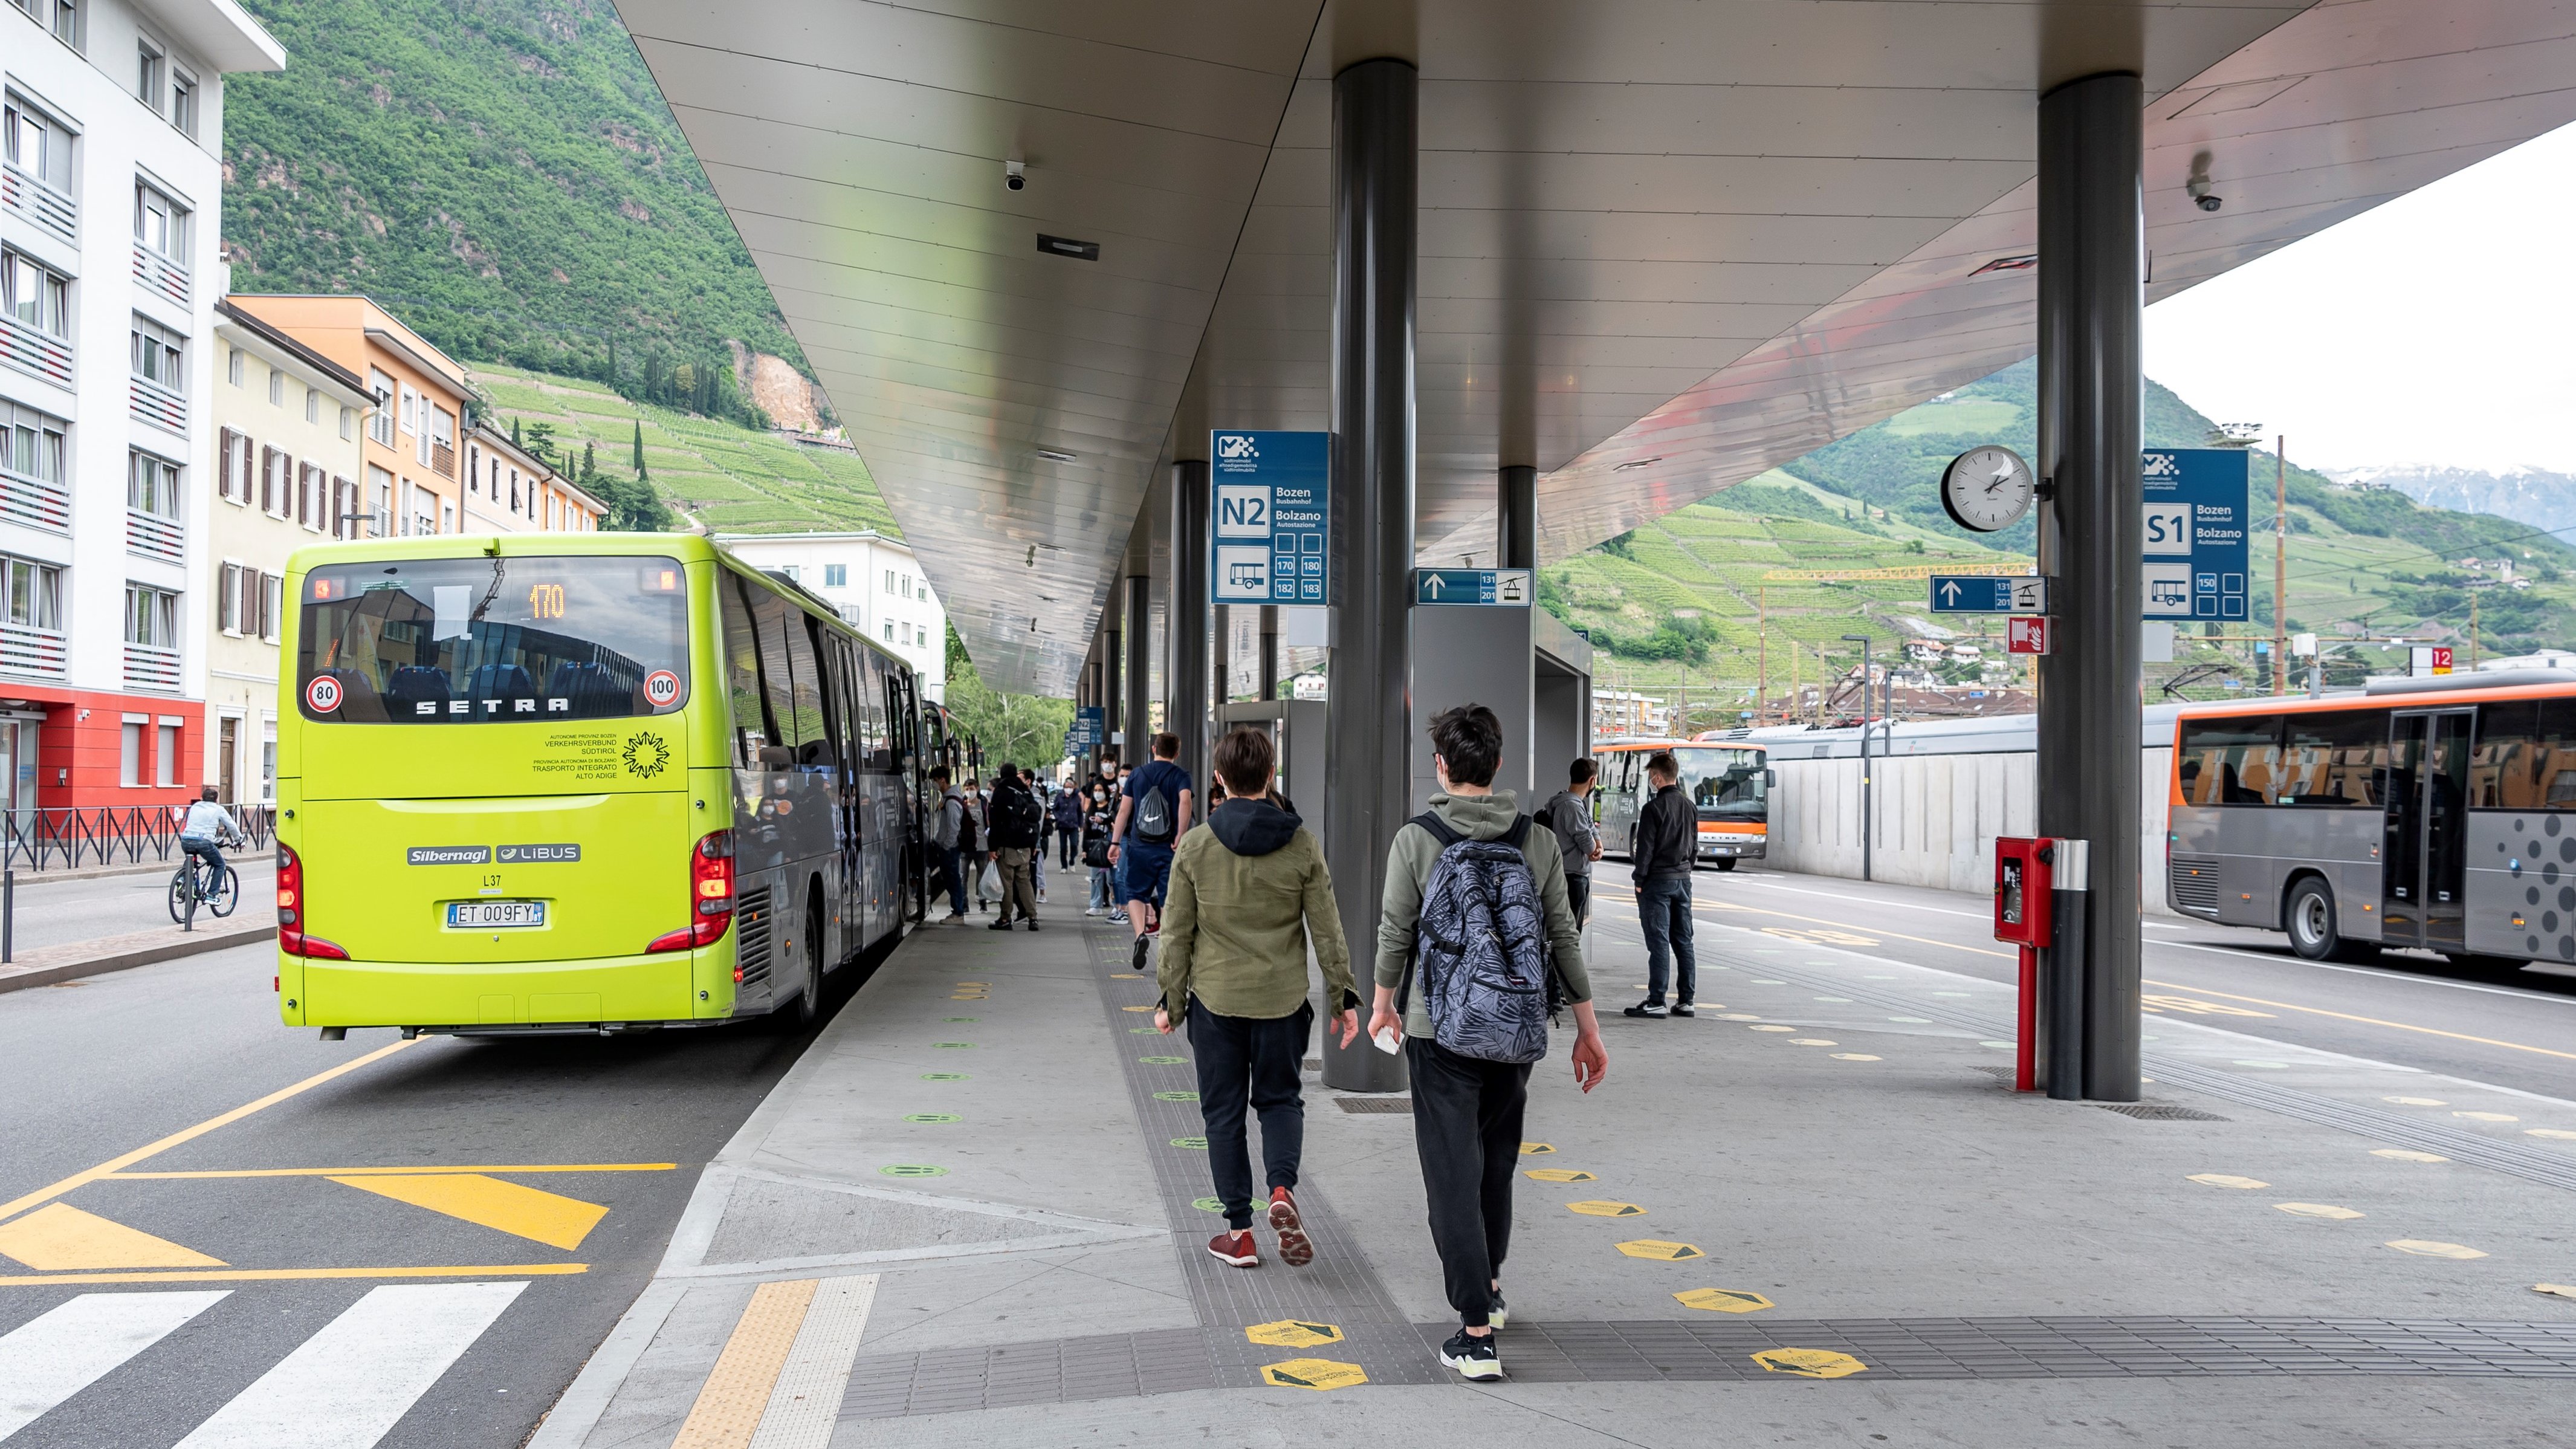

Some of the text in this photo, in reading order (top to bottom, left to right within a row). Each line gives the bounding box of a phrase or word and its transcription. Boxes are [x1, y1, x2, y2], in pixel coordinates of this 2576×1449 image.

[1276, 487, 1311, 497] Bozen
[1222, 498, 1265, 525] N2
[2196, 504, 2231, 514] Bozen
[1275, 510, 1321, 520] Bolzano
[2147, 515, 2183, 542] S1
[2196, 527, 2242, 538] Bolzano
[1277, 561, 1293, 571] 170
[1303, 562, 1319, 571] 180
[1482, 575, 1495, 584] 131
[2198, 579, 2215, 588] 150
[1277, 584, 1293, 594] 182
[1303, 584, 1319, 594] 183
[1481, 591, 1495, 600] 201
[529, 584, 565, 618] 170
[2433, 651, 2451, 665] 12
[651, 680, 674, 693] 100
[316, 686, 333, 699] 80
[416, 698, 569, 715] SETRA
[411, 849, 487, 863] Silbernagl
[459, 906, 477, 922] ET
